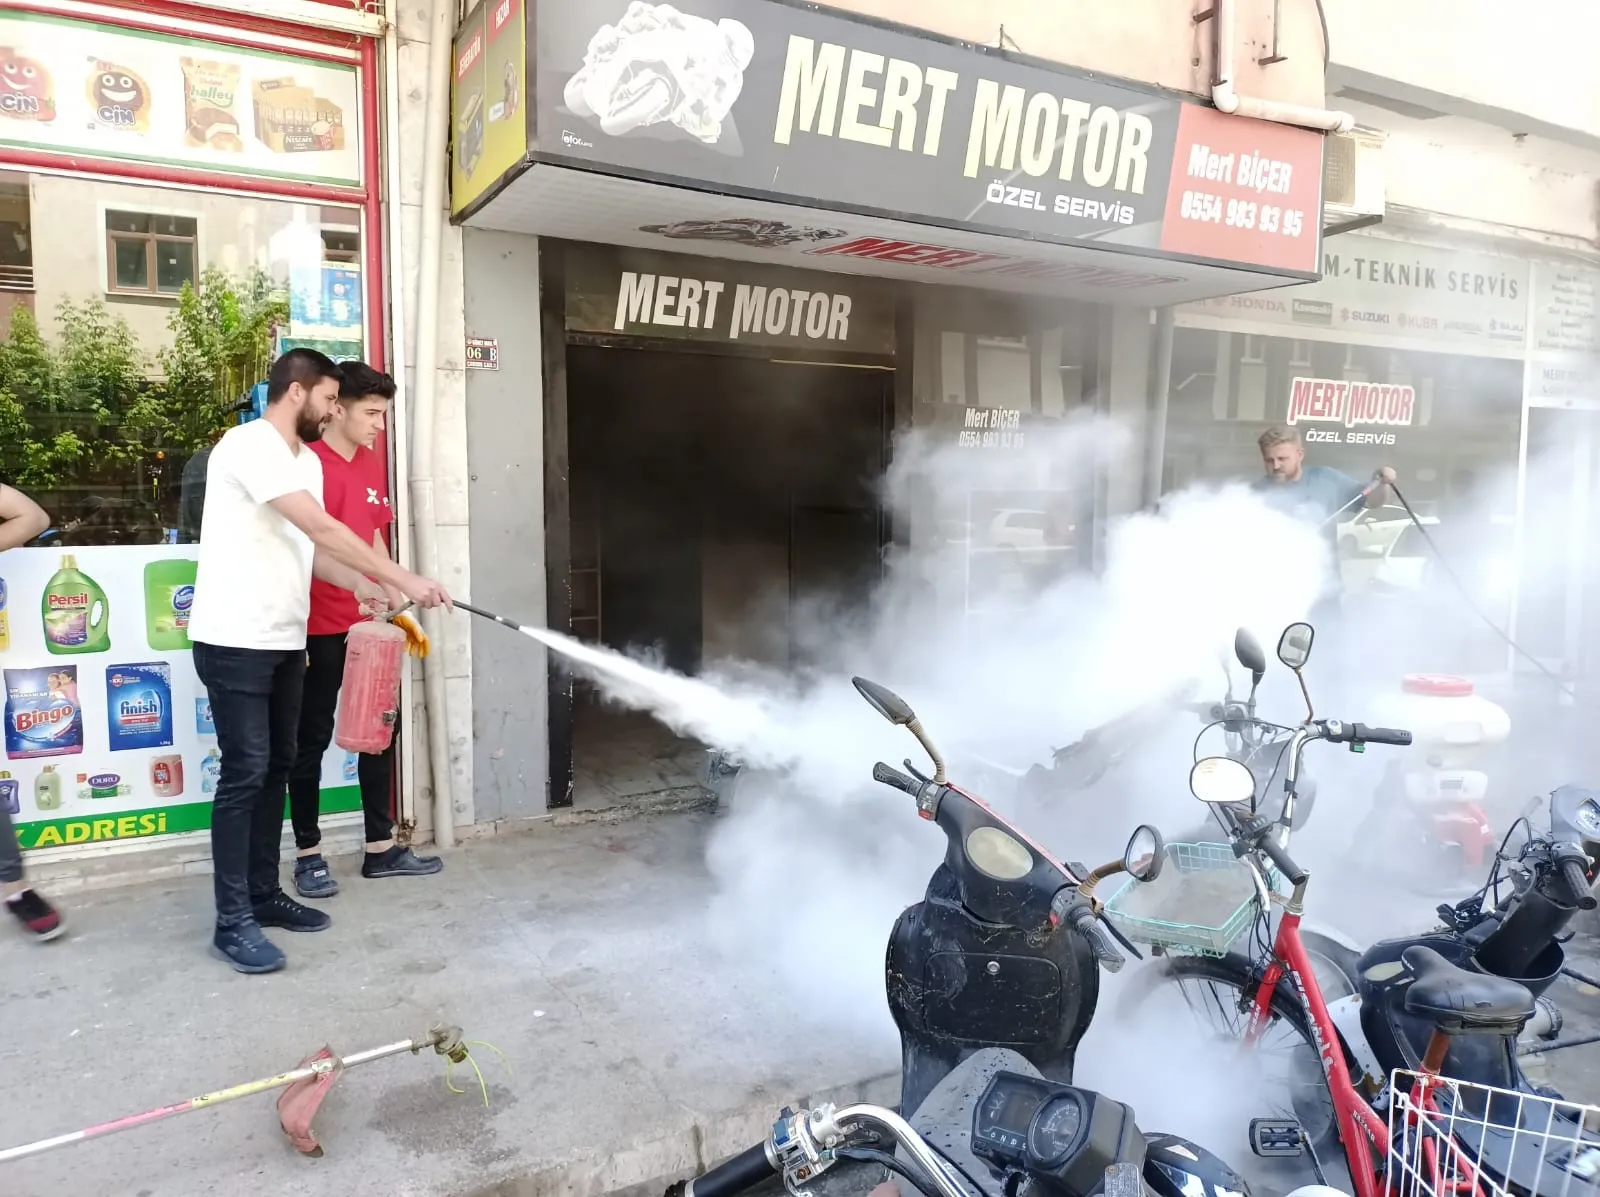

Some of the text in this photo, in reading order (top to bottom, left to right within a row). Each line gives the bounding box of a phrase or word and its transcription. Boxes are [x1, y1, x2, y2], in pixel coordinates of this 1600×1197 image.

[773, 34, 1153, 195] MERT MOTOR
[1187, 143, 1293, 194] Mert BİÇER
[986, 179, 1047, 211] ÖZEL
[1181, 190, 1304, 238] 0554 983 93 95
[613, 271, 852, 341] MERT MOTOR
[1231, 297, 1287, 313] HONDA
[1352, 310, 1390, 324] SUZUKI
[1288, 377, 1415, 427] MERT MOTOR
[964, 407, 989, 428] Mert
[1305, 428, 1342, 443] ÖZEL
[48, 592, 88, 606] Persil
[15, 704, 73, 732] Bingo
[120, 700, 157, 715] finish
